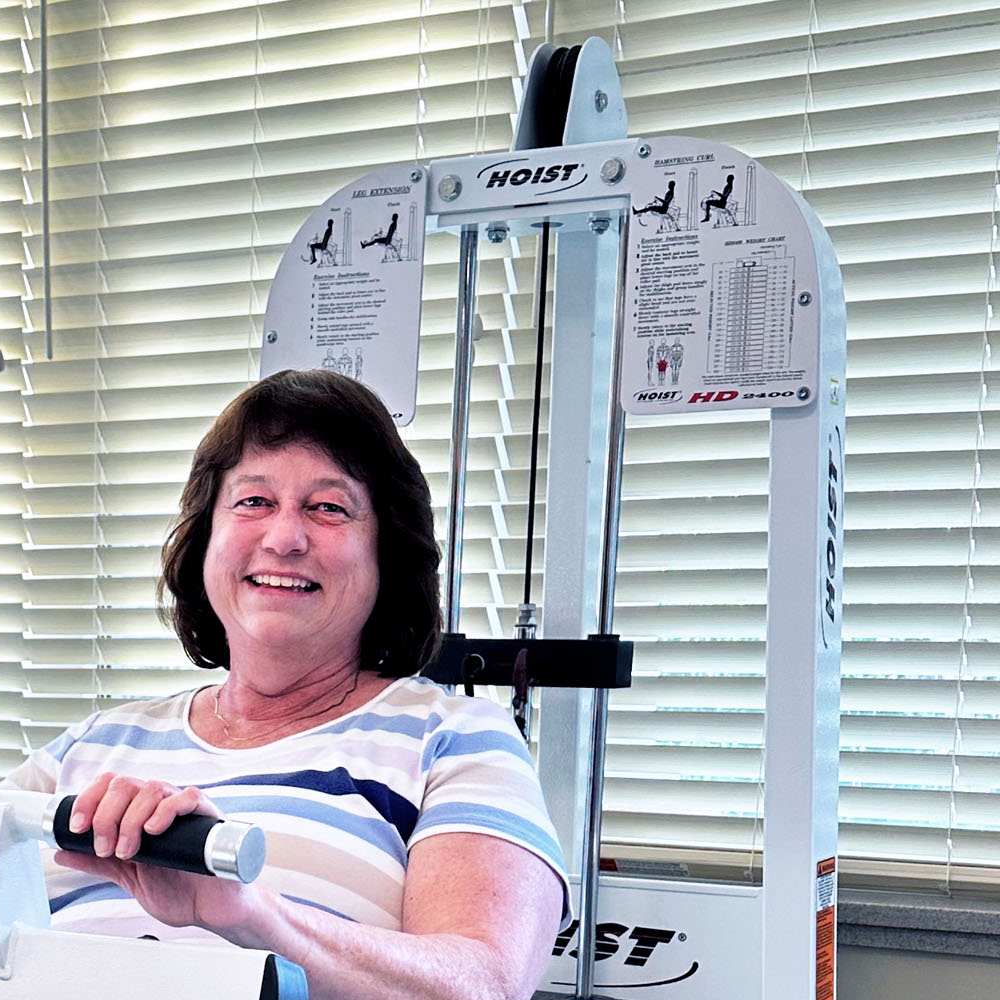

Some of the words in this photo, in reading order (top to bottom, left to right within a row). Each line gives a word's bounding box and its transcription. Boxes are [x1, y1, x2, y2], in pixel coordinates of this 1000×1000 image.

[486, 164, 579, 188] HOIST
[370, 185, 412, 196] EXTENSION
[637, 391, 678, 401] HOIST
[687, 390, 739, 403] HD
[743, 391, 795, 399] 2400
[825, 448, 838, 623] HOIST
[551, 920, 676, 967] IST
